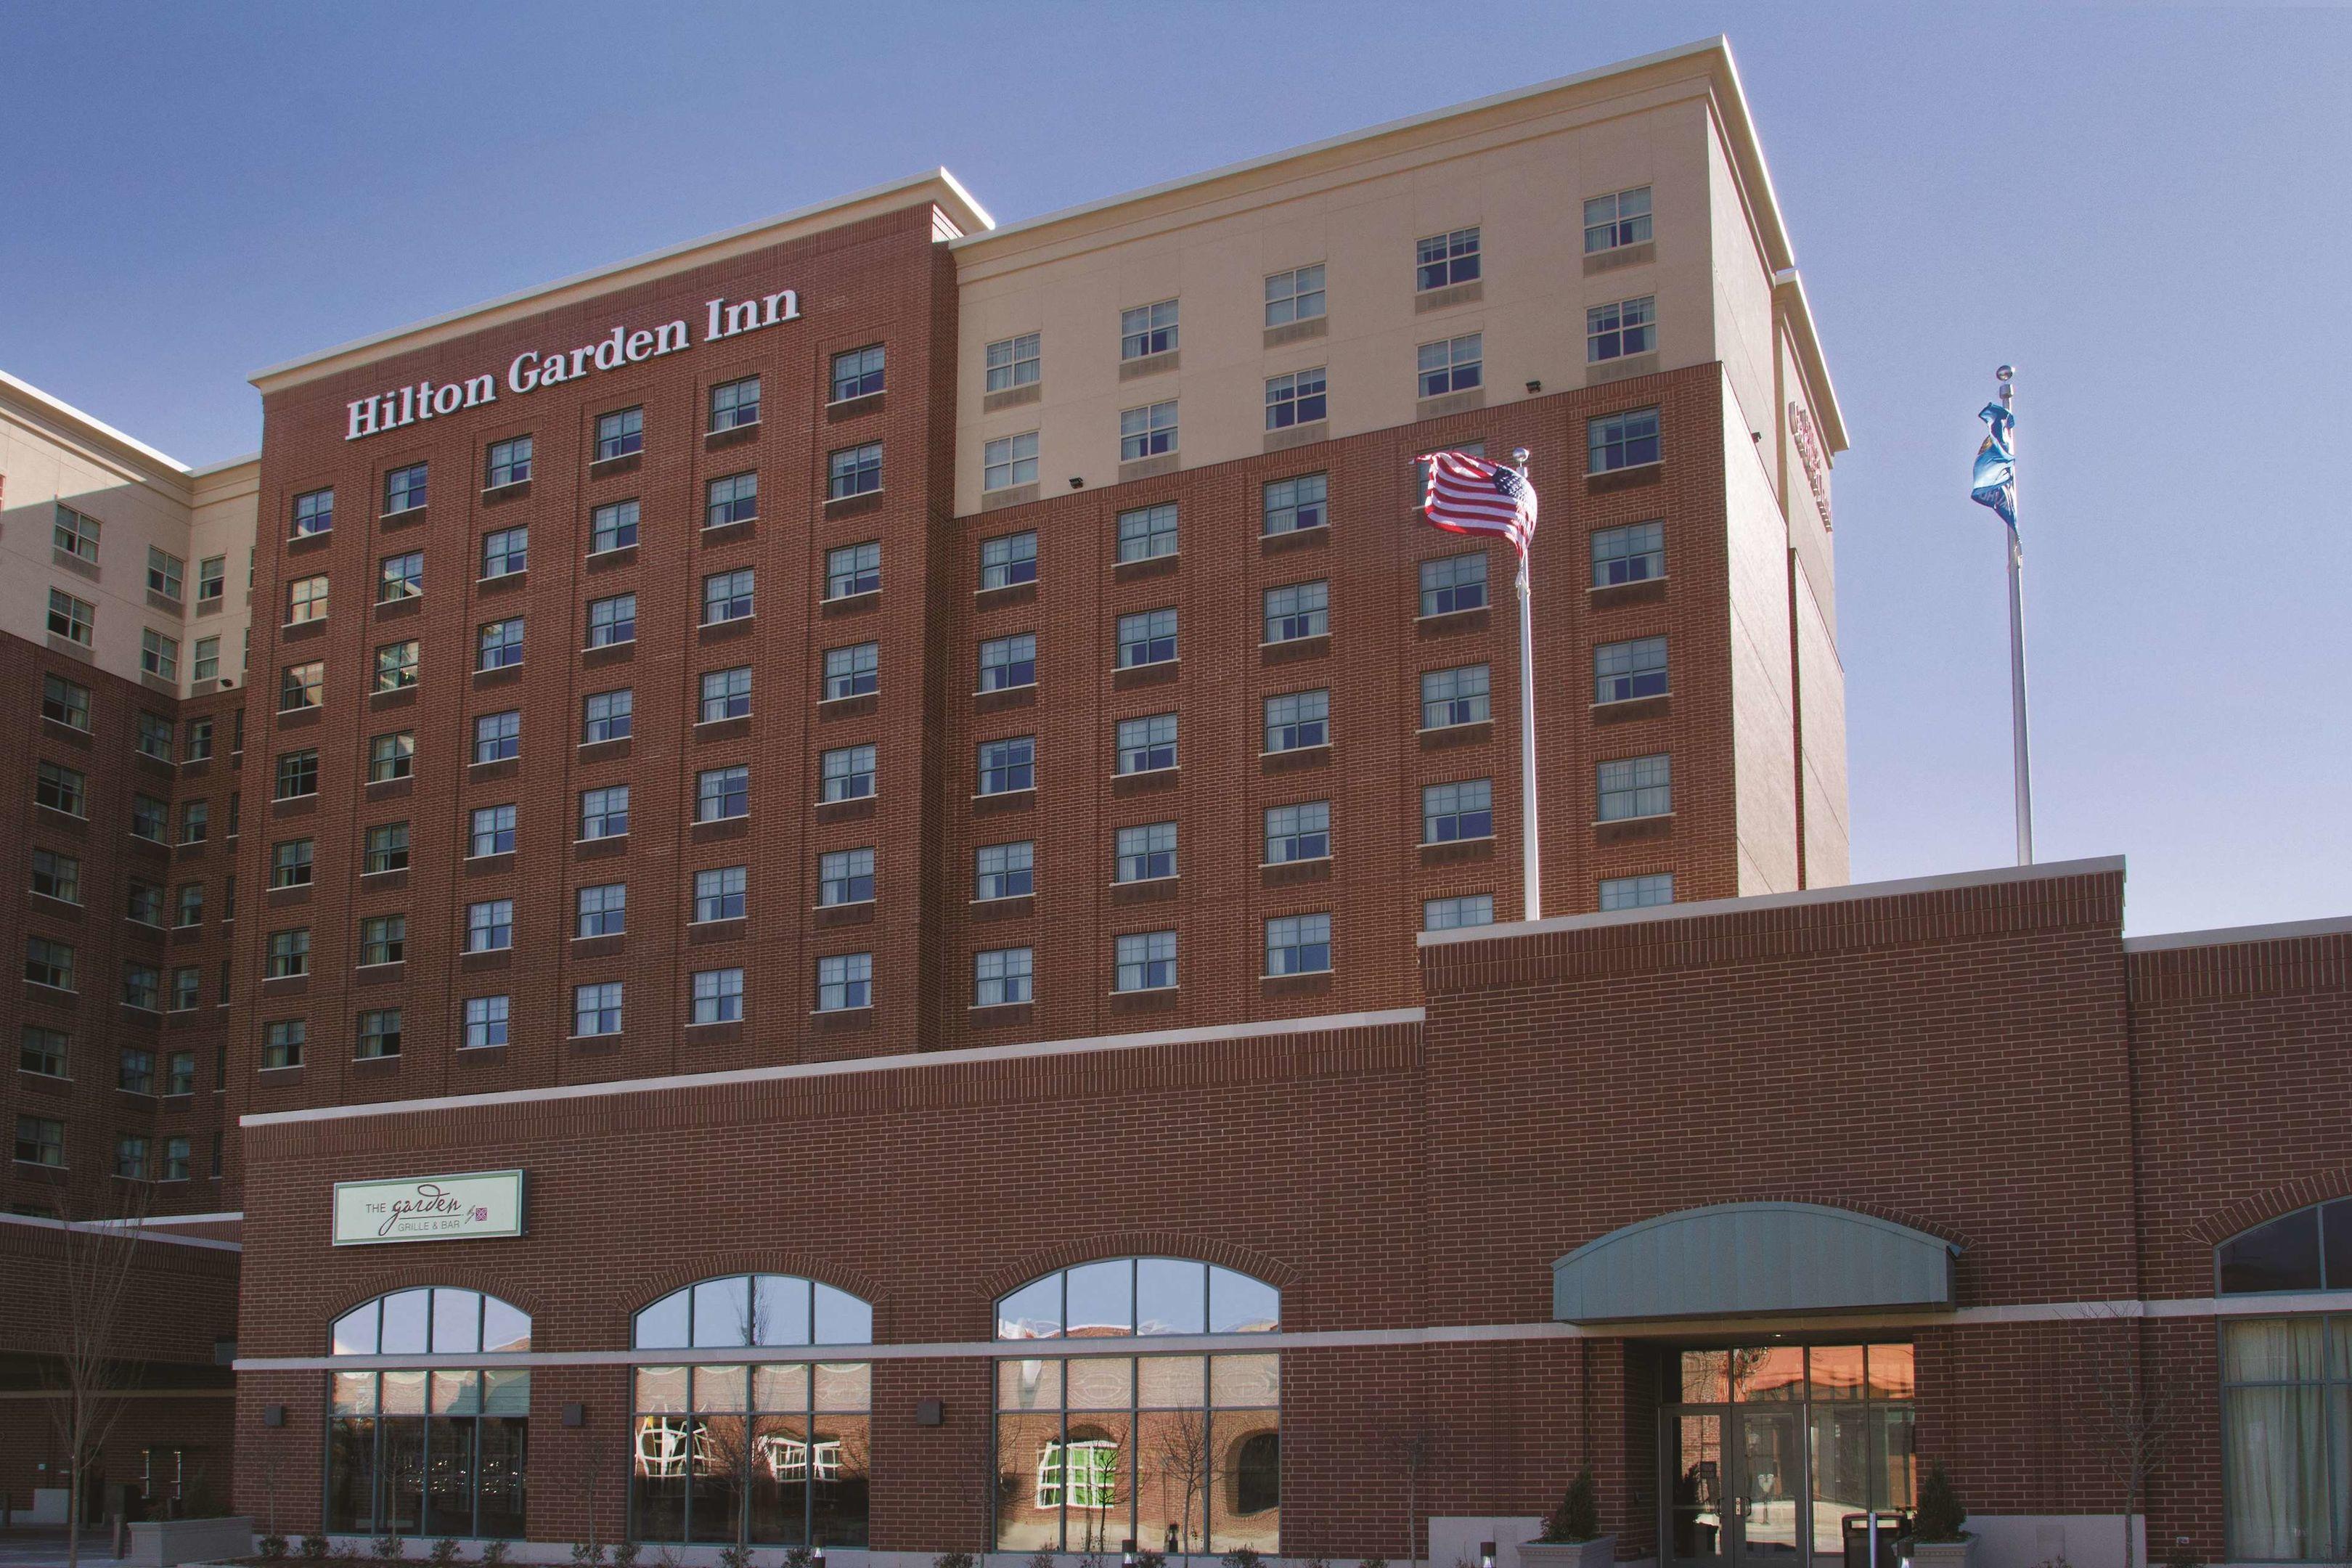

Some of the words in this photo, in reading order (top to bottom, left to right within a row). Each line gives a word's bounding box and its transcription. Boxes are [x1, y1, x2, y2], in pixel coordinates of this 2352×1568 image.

[345, 373, 497, 441] Hilton
[508, 318, 690, 393] Garden
[704, 289, 800, 342] Inn
[366, 1204, 385, 1213] THE
[379, 1185, 461, 1236] garden
[398, 1222, 429, 1232] GRILLE
[441, 1220, 460, 1230] BAR
